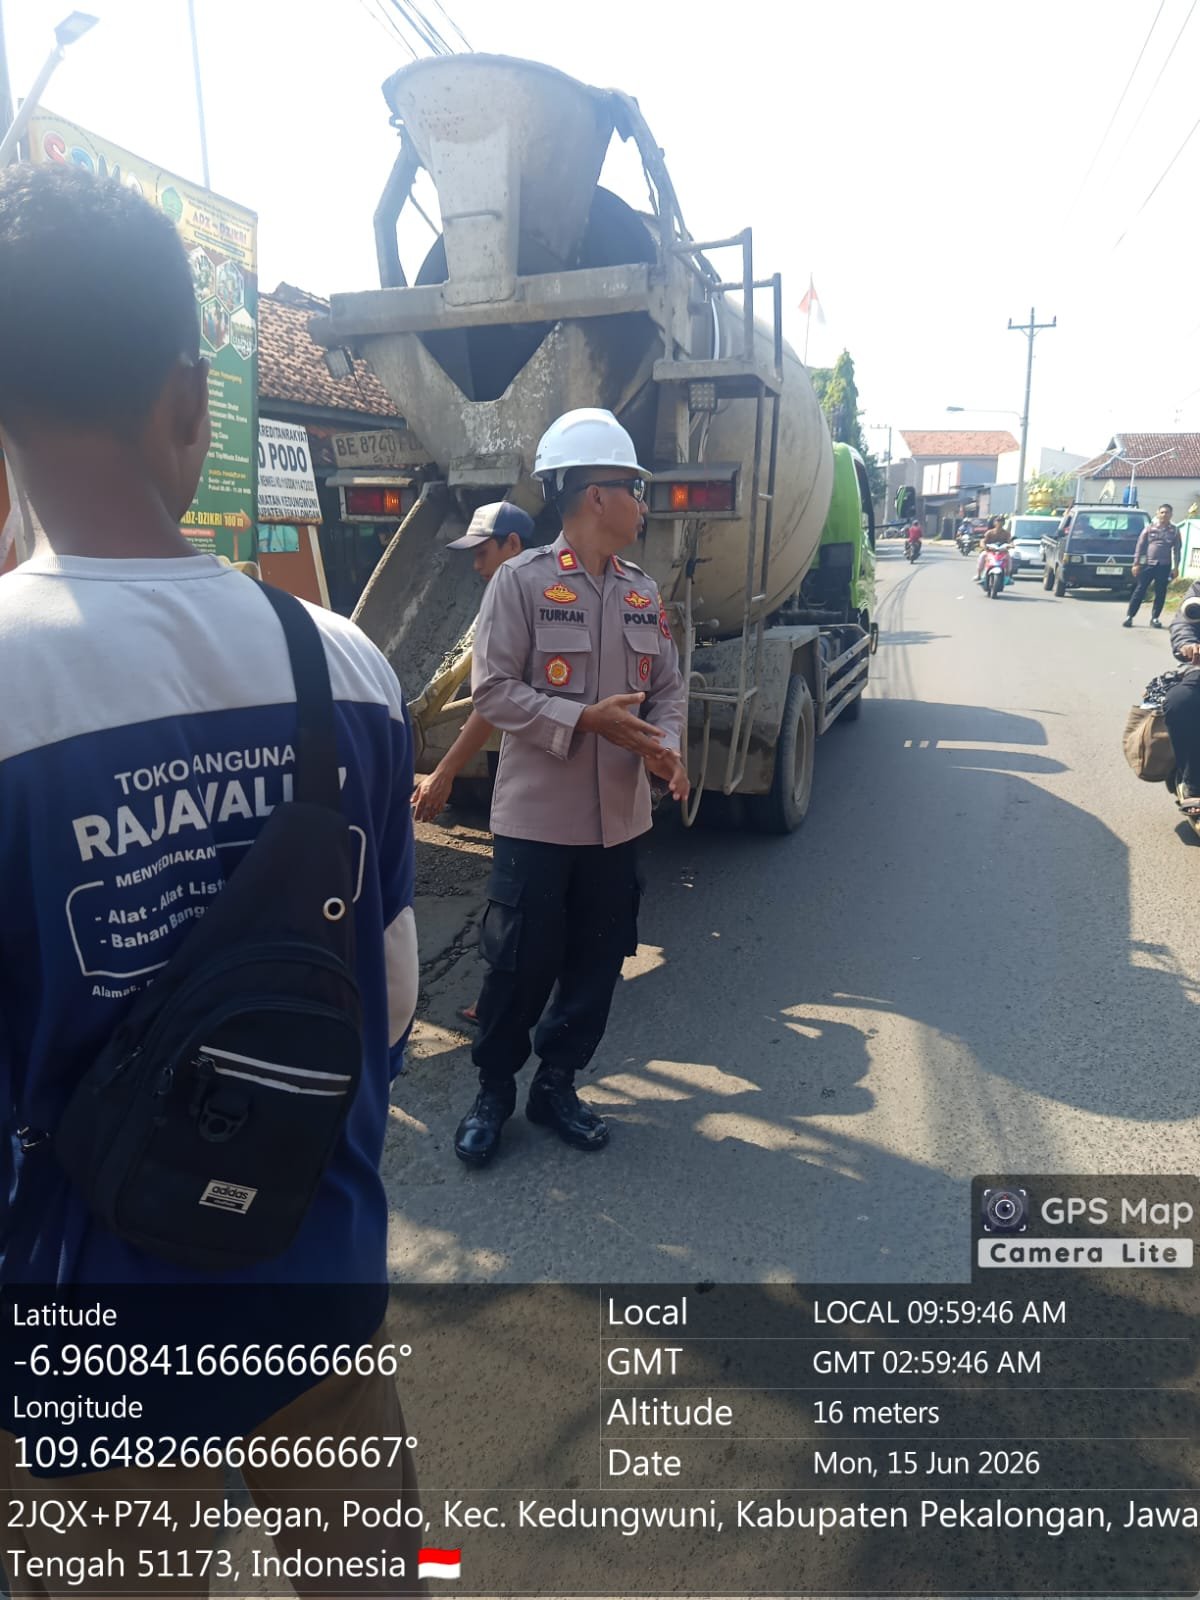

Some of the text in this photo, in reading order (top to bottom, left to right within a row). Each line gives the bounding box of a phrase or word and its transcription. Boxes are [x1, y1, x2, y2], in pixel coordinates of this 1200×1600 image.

[268, 442, 308, 472] PODO
[335, 436, 358, 457] BE
[539, 608, 585, 624] TURKAN
[623, 612, 658, 625] POLRI
[114, 744, 296, 795] TOKO ANGUNA
[115, 845, 217, 888] MENYEDIAKAN
[108, 906, 148, 925] Alat
[160, 884, 184, 911] Alat
[188, 880, 226, 896] List
[111, 923, 169, 949] Bahan
[169, 905, 209, 930] Bang
[212, 1186, 248, 1200] adidas
